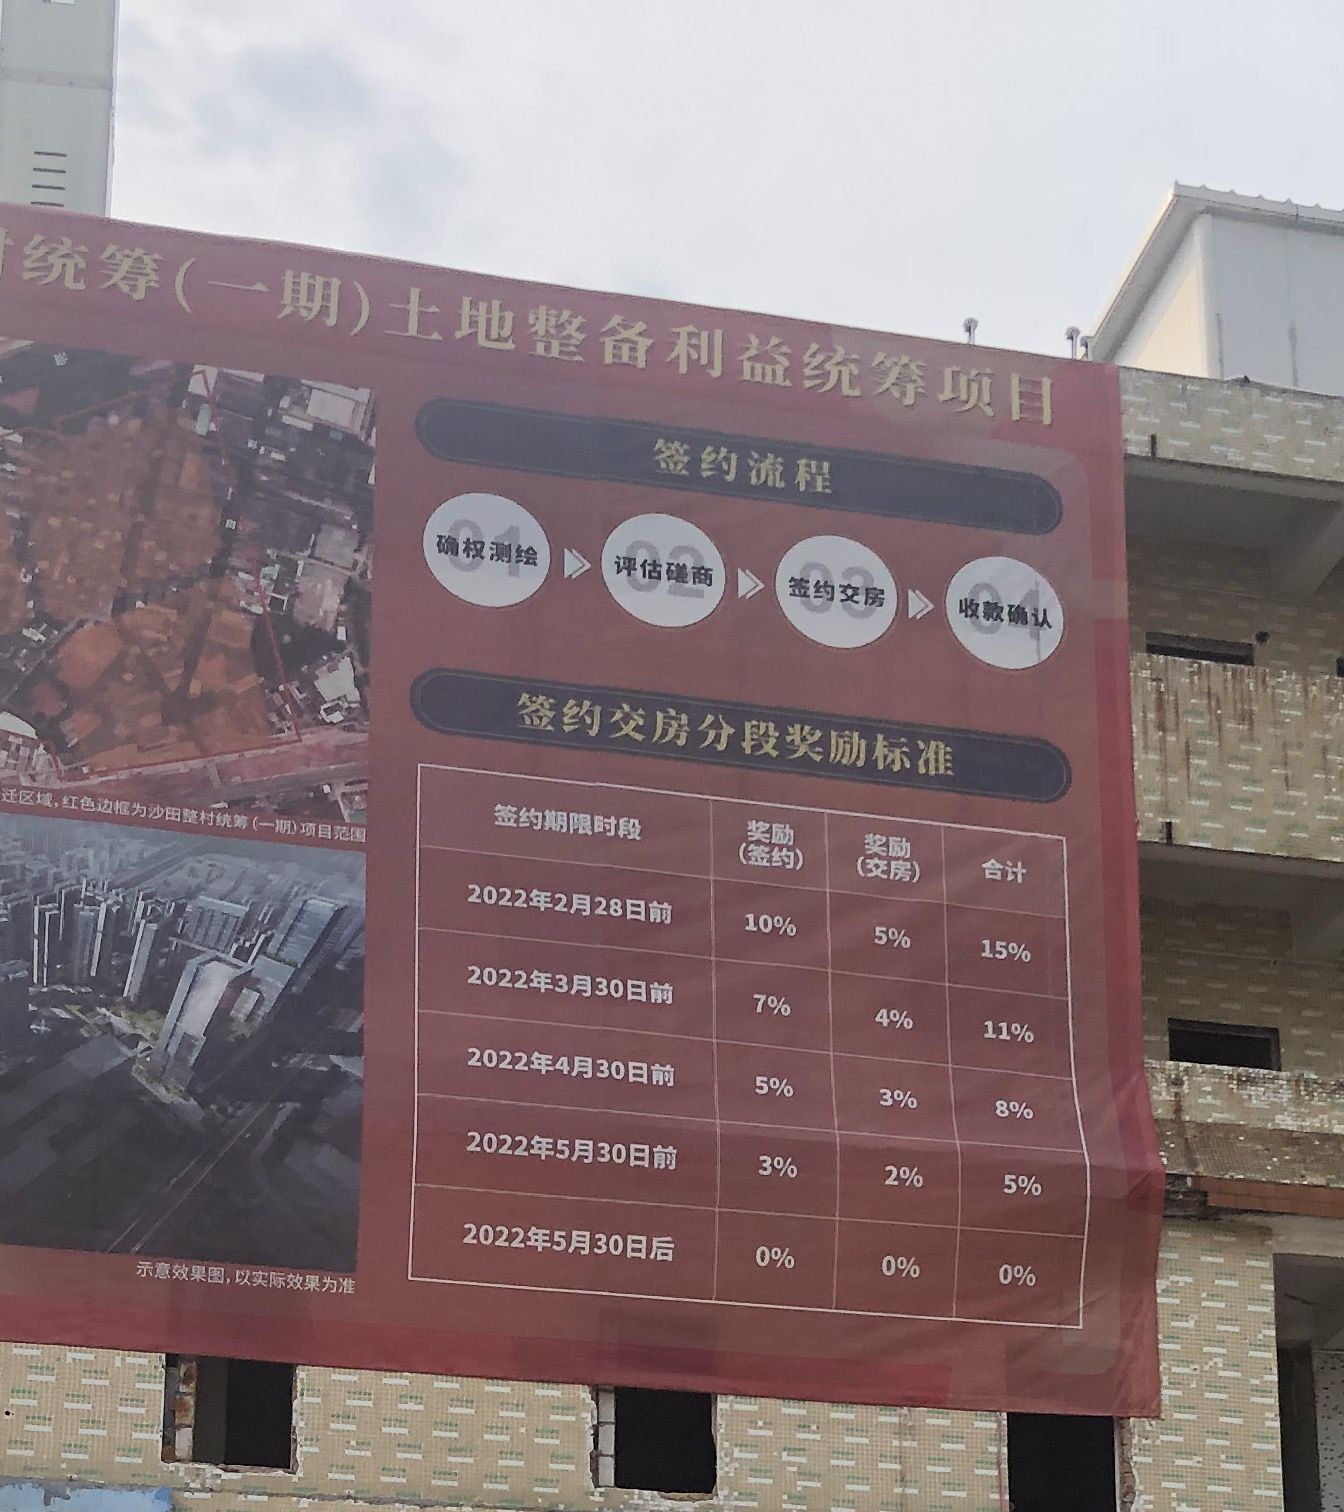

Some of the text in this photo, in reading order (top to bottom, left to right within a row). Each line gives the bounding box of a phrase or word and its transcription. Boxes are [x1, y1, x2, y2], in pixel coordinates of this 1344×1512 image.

[653, 437, 833, 496] 签约流程
[435, 533, 539, 568] 确权测绘
[787, 575, 886, 610] 签约交房
[958, 597, 1053, 630] 收款确认
[517, 692, 955, 778] 签约交房分段奖励标准
[493, 803, 643, 842] 签约期限时段
[747, 819, 795, 847] 奖励
[864, 832, 912, 861] 奖励
[981, 857, 1027, 885] 合计
[466, 882, 673, 926] 2022年2月28日前
[744, 912, 797, 938] 10%
[874, 926, 911, 949] 5%
[981, 938, 1032, 964] 15%
[466, 964, 674, 1007] 2022年3月30日前
[753, 993, 792, 1017] 7%
[875, 1007, 914, 1031] 4%
[983, 1020, 1035, 1044] 11%
[466, 1046, 675, 1088] 2022年4月30日前
[755, 1075, 794, 1098] 5%
[879, 1087, 918, 1110] 3%
[994, 1098, 1034, 1121] 8%
[465, 1130, 678, 1171] 2022年5月30日前
[757, 1154, 798, 1179] 3%
[884, 1164, 924, 1189] 2%
[1002, 1172, 1042, 1197] 5%
[462, 1222, 675, 1262] 2022年5月30日后
[755, 1245, 795, 1270] 0%
[881, 1254, 921, 1279] 0%
[998, 1262, 1037, 1287] 0%
